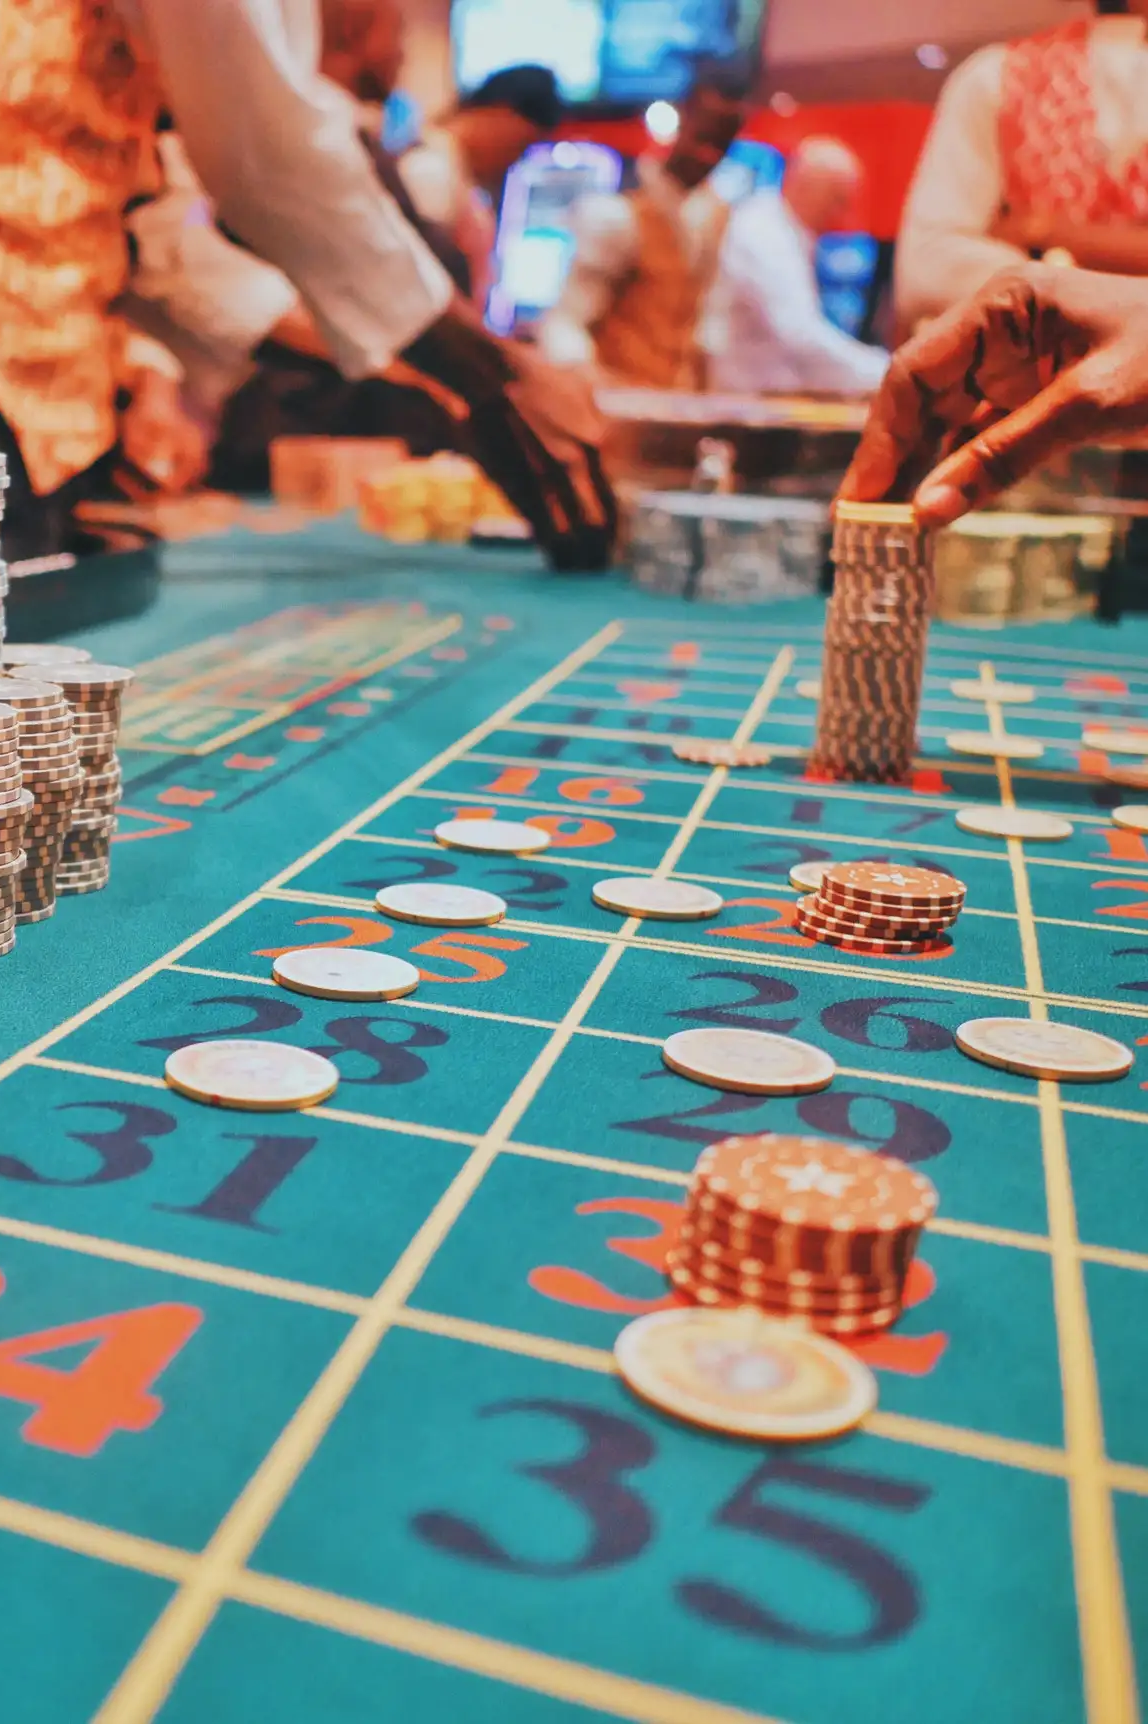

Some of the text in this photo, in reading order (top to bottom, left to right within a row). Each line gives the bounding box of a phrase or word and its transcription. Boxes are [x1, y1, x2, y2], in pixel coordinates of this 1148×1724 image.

[474, 767, 649, 806] 16
[786, 800, 946, 834] 17
[343, 856, 569, 911] 22
[735, 840, 954, 877] 2
[252, 916, 529, 983] 25
[704, 897, 954, 960] 2
[135, 995, 449, 1085] 28
[664, 970, 954, 1053] 26
[528, 1197, 948, 1376] 3
[407, 1396, 933, 1655] 35
